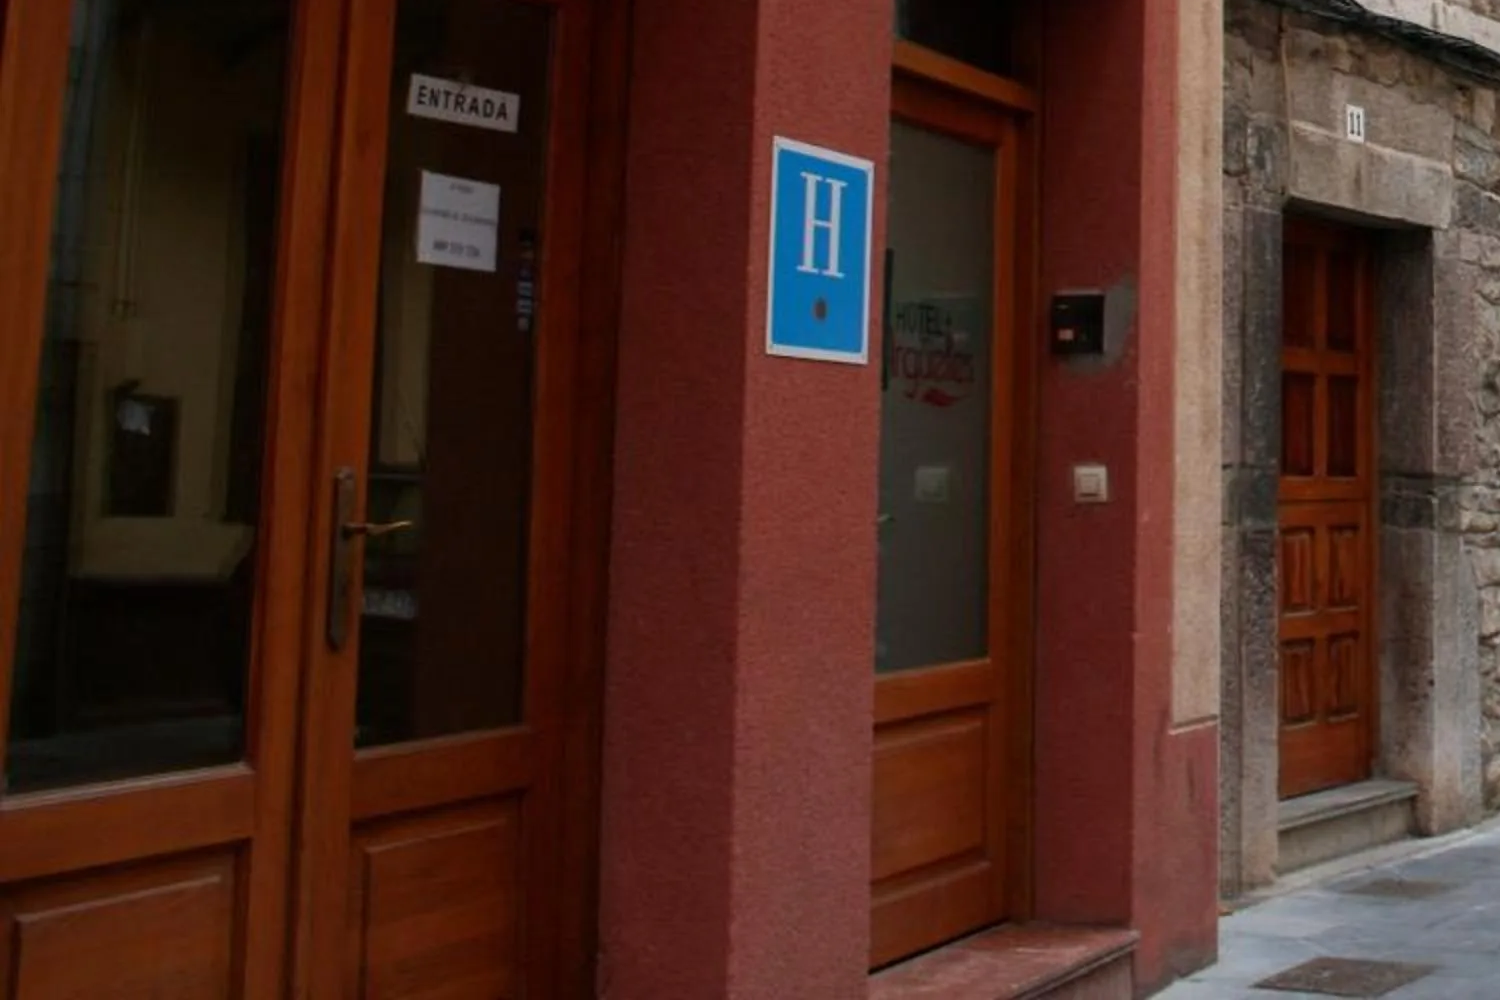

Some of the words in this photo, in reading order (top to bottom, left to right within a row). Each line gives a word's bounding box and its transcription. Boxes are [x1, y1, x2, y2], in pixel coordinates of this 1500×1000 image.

[416, 84, 508, 121] ENTRADA
[1349, 111, 1361, 137] 11
[796, 171, 848, 279] H
